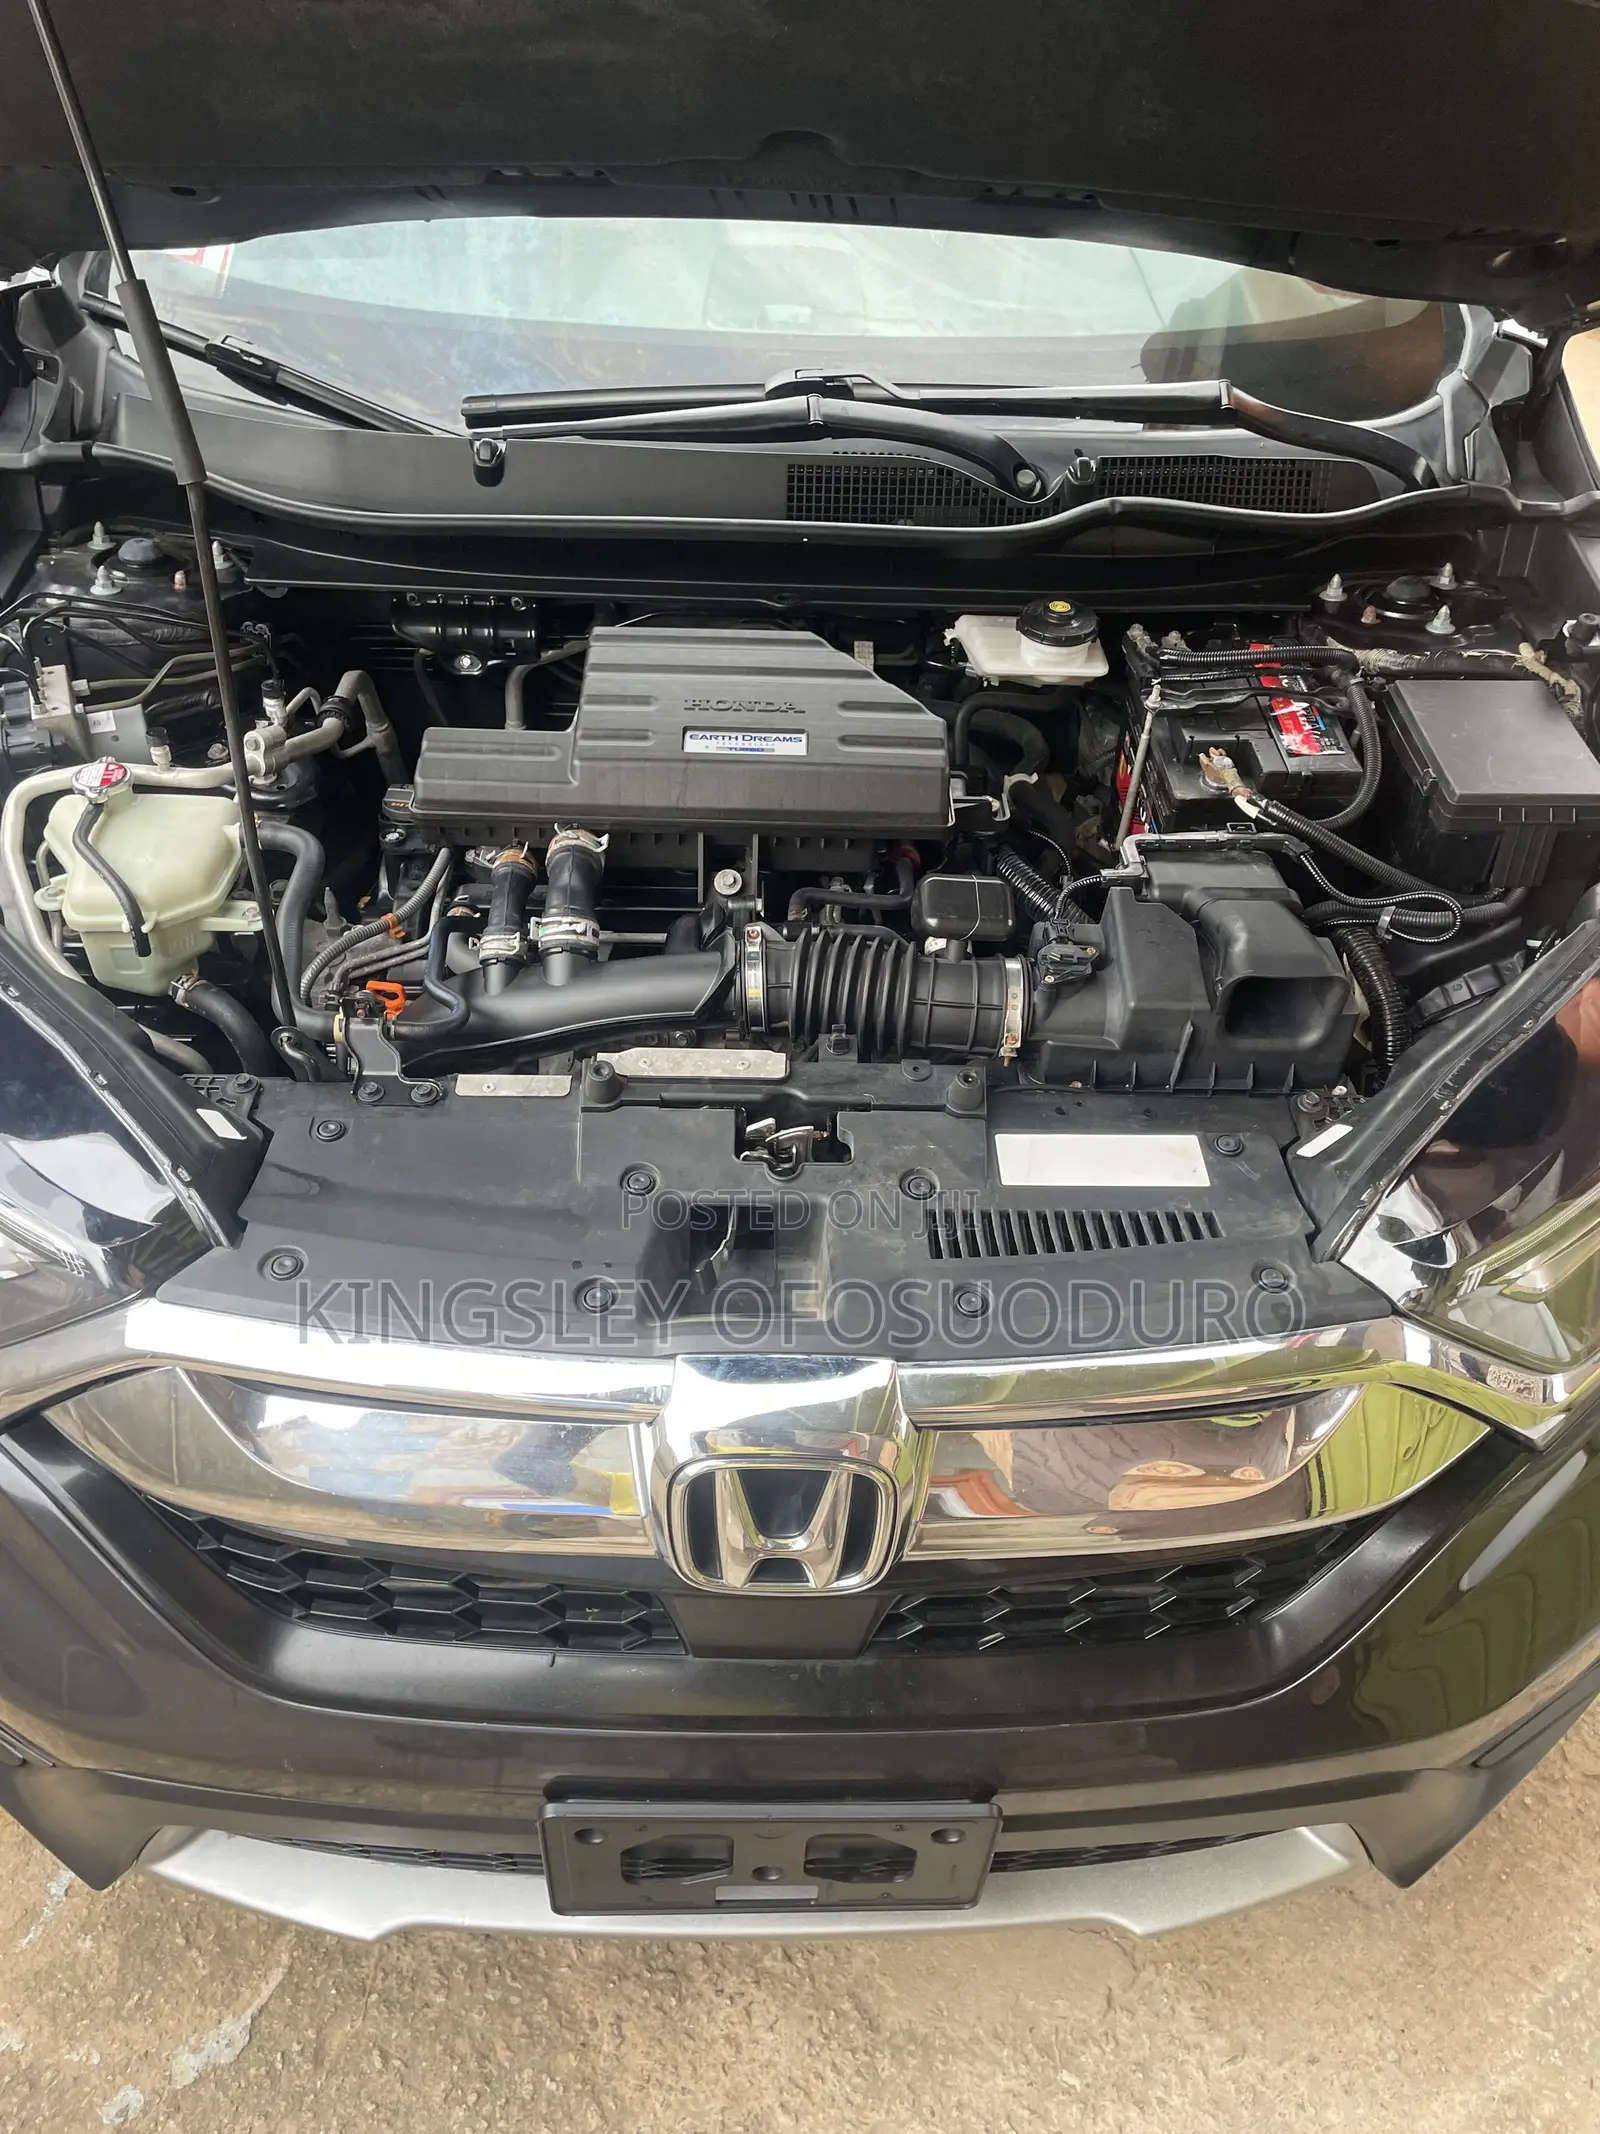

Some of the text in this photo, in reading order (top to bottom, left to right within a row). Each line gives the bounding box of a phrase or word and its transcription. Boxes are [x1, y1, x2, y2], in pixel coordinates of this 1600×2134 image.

[684, 699, 806, 714] HONDA
[689, 733, 803, 743] EARTH DREAMS
